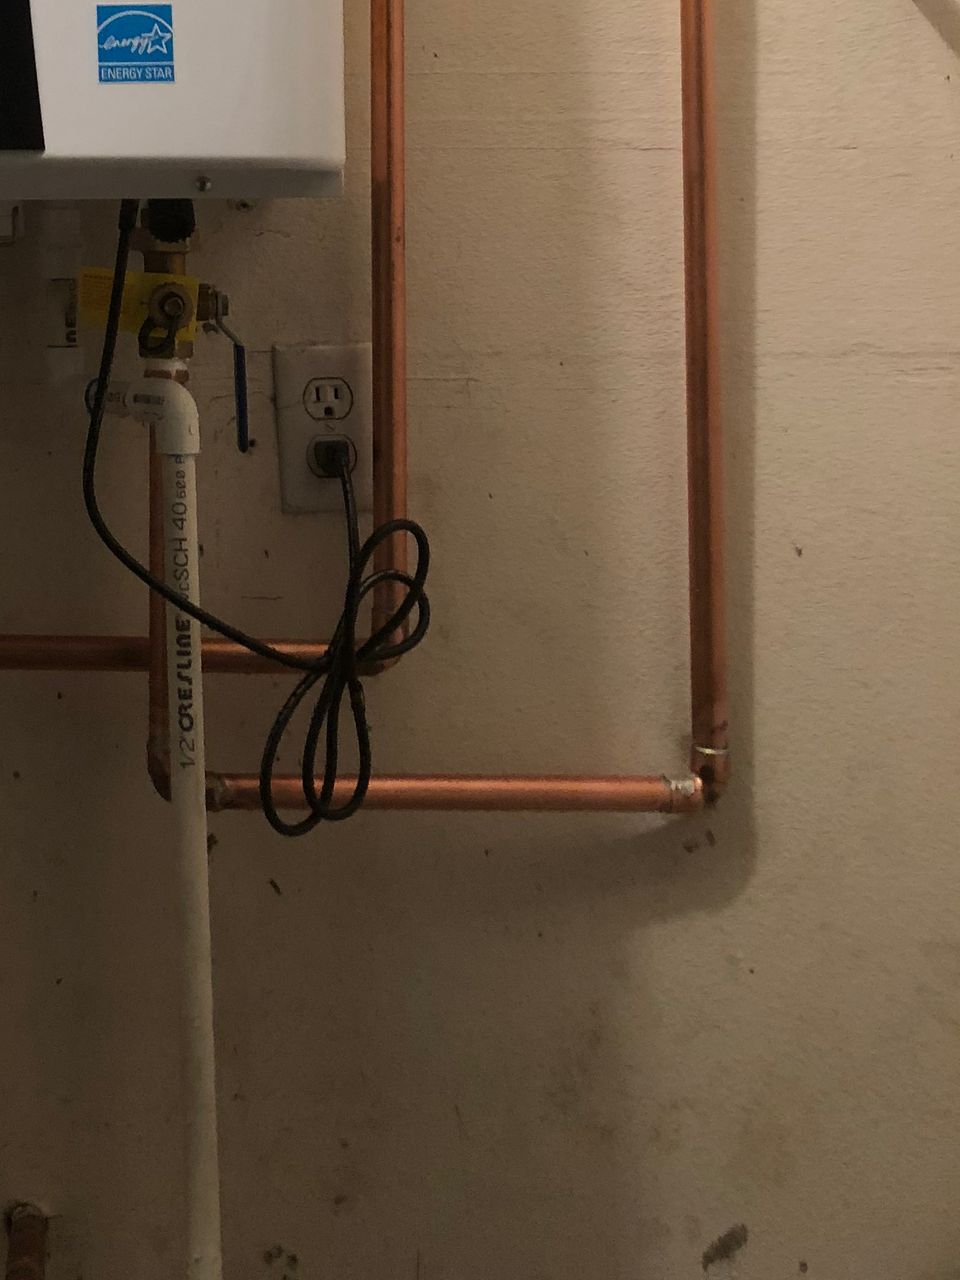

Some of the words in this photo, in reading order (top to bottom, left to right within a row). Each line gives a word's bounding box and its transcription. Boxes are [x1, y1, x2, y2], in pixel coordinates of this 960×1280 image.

[101, 66, 143, 81] ENERGY
[144, 65, 173, 80] STAR
[171, 502, 188, 531] 40
[171, 537, 190, 581] SCH
